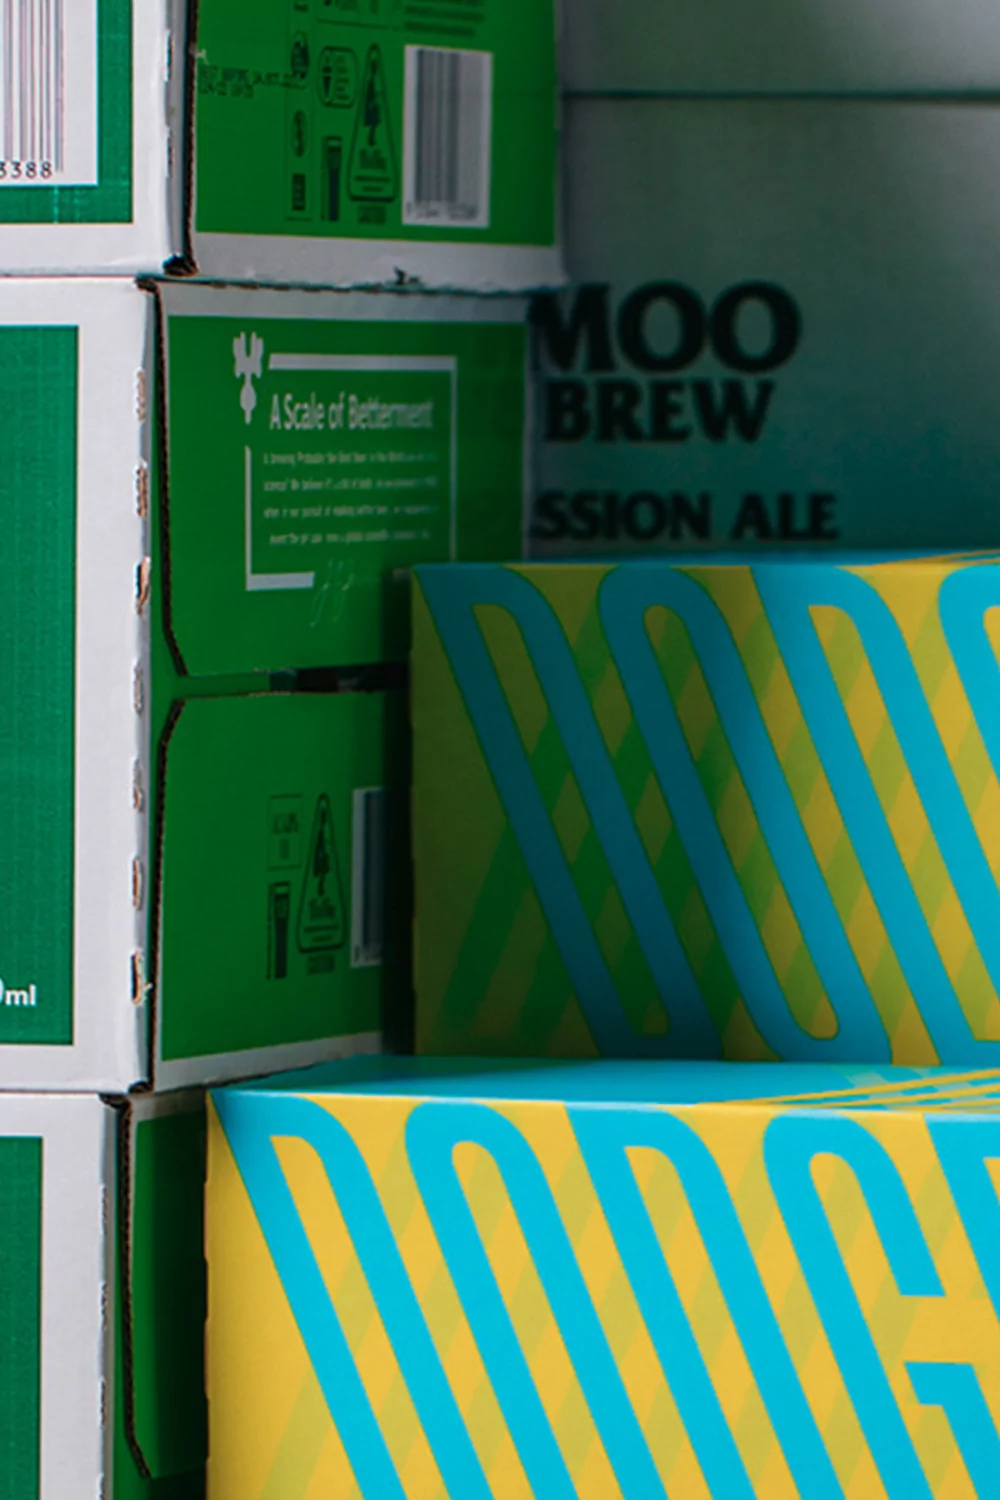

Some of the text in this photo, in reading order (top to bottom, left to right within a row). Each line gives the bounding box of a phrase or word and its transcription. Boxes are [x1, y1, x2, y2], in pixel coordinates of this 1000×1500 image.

[528, 279, 803, 375] MOO
[269, 393, 282, 430] A
[284, 392, 325, 430] Scale
[328, 391, 344, 430] of
[545, 377, 776, 444] BREW
[731, 491, 840, 543] ALE
